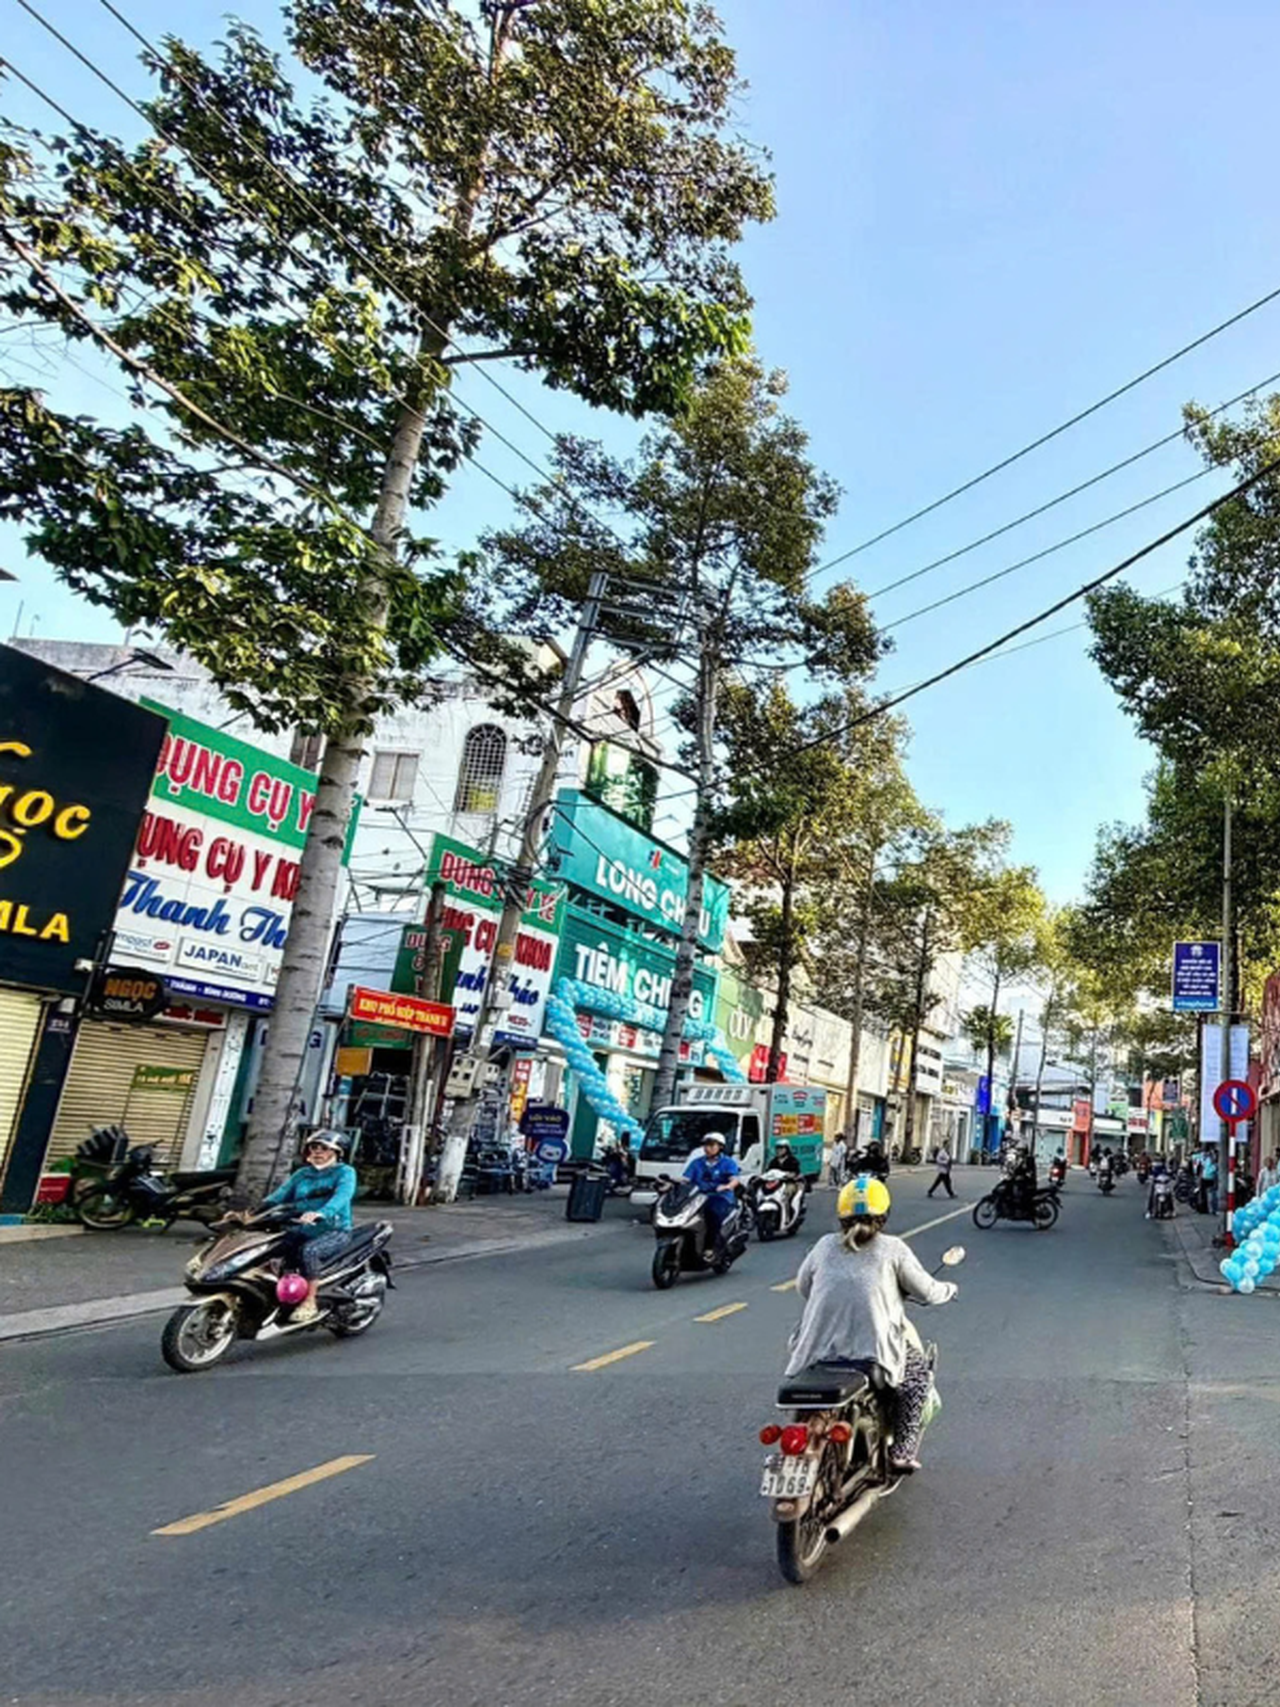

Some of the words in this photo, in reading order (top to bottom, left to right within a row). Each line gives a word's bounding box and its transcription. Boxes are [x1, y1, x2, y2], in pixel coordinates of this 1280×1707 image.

[248, 771, 293, 831] CỤ
[136, 812, 204, 871] ỤNG
[207, 837, 246, 893] CỤ
[253, 850, 271, 892] Y
[596, 855, 658, 911] LONG
[660, 889, 712, 937] CHU
[104, 978, 158, 1002] NGỌC
[575, 941, 629, 997] TIÊM
[633, 966, 704, 1019] CHG
